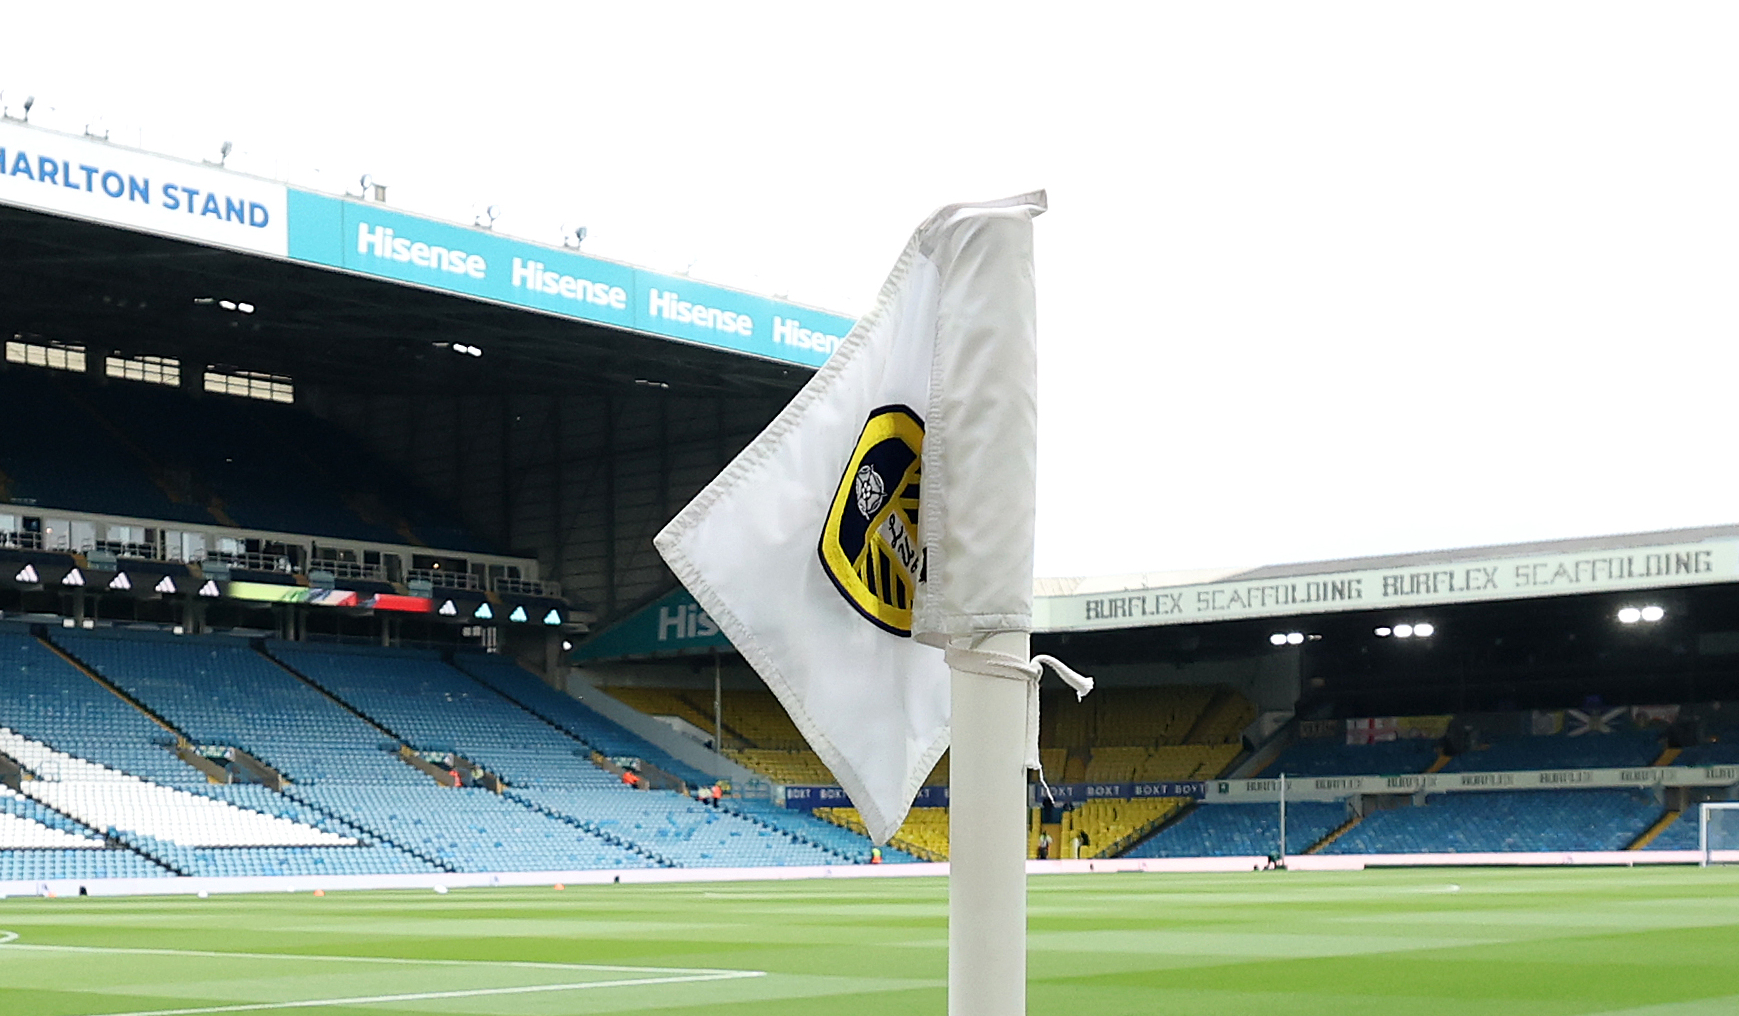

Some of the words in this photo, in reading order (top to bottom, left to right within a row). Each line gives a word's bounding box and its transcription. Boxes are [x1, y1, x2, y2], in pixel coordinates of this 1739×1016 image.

[161, 183, 270, 228] STAND
[357, 221, 487, 279] Hisense
[512, 256, 627, 311] Hisense
[649, 286, 753, 337] Hisense
[772, 315, 845, 354] Hisen
[1086, 592, 1184, 620] BURFLEX
[1197, 578, 1363, 612] SCAFFOLDING
[1382, 566, 1499, 597] BURFLEX
[1515, 550, 1713, 587] SCAFFOLDING
[1087, 785, 1120, 797] BOXT
[1135, 784, 1168, 796] BOXT
